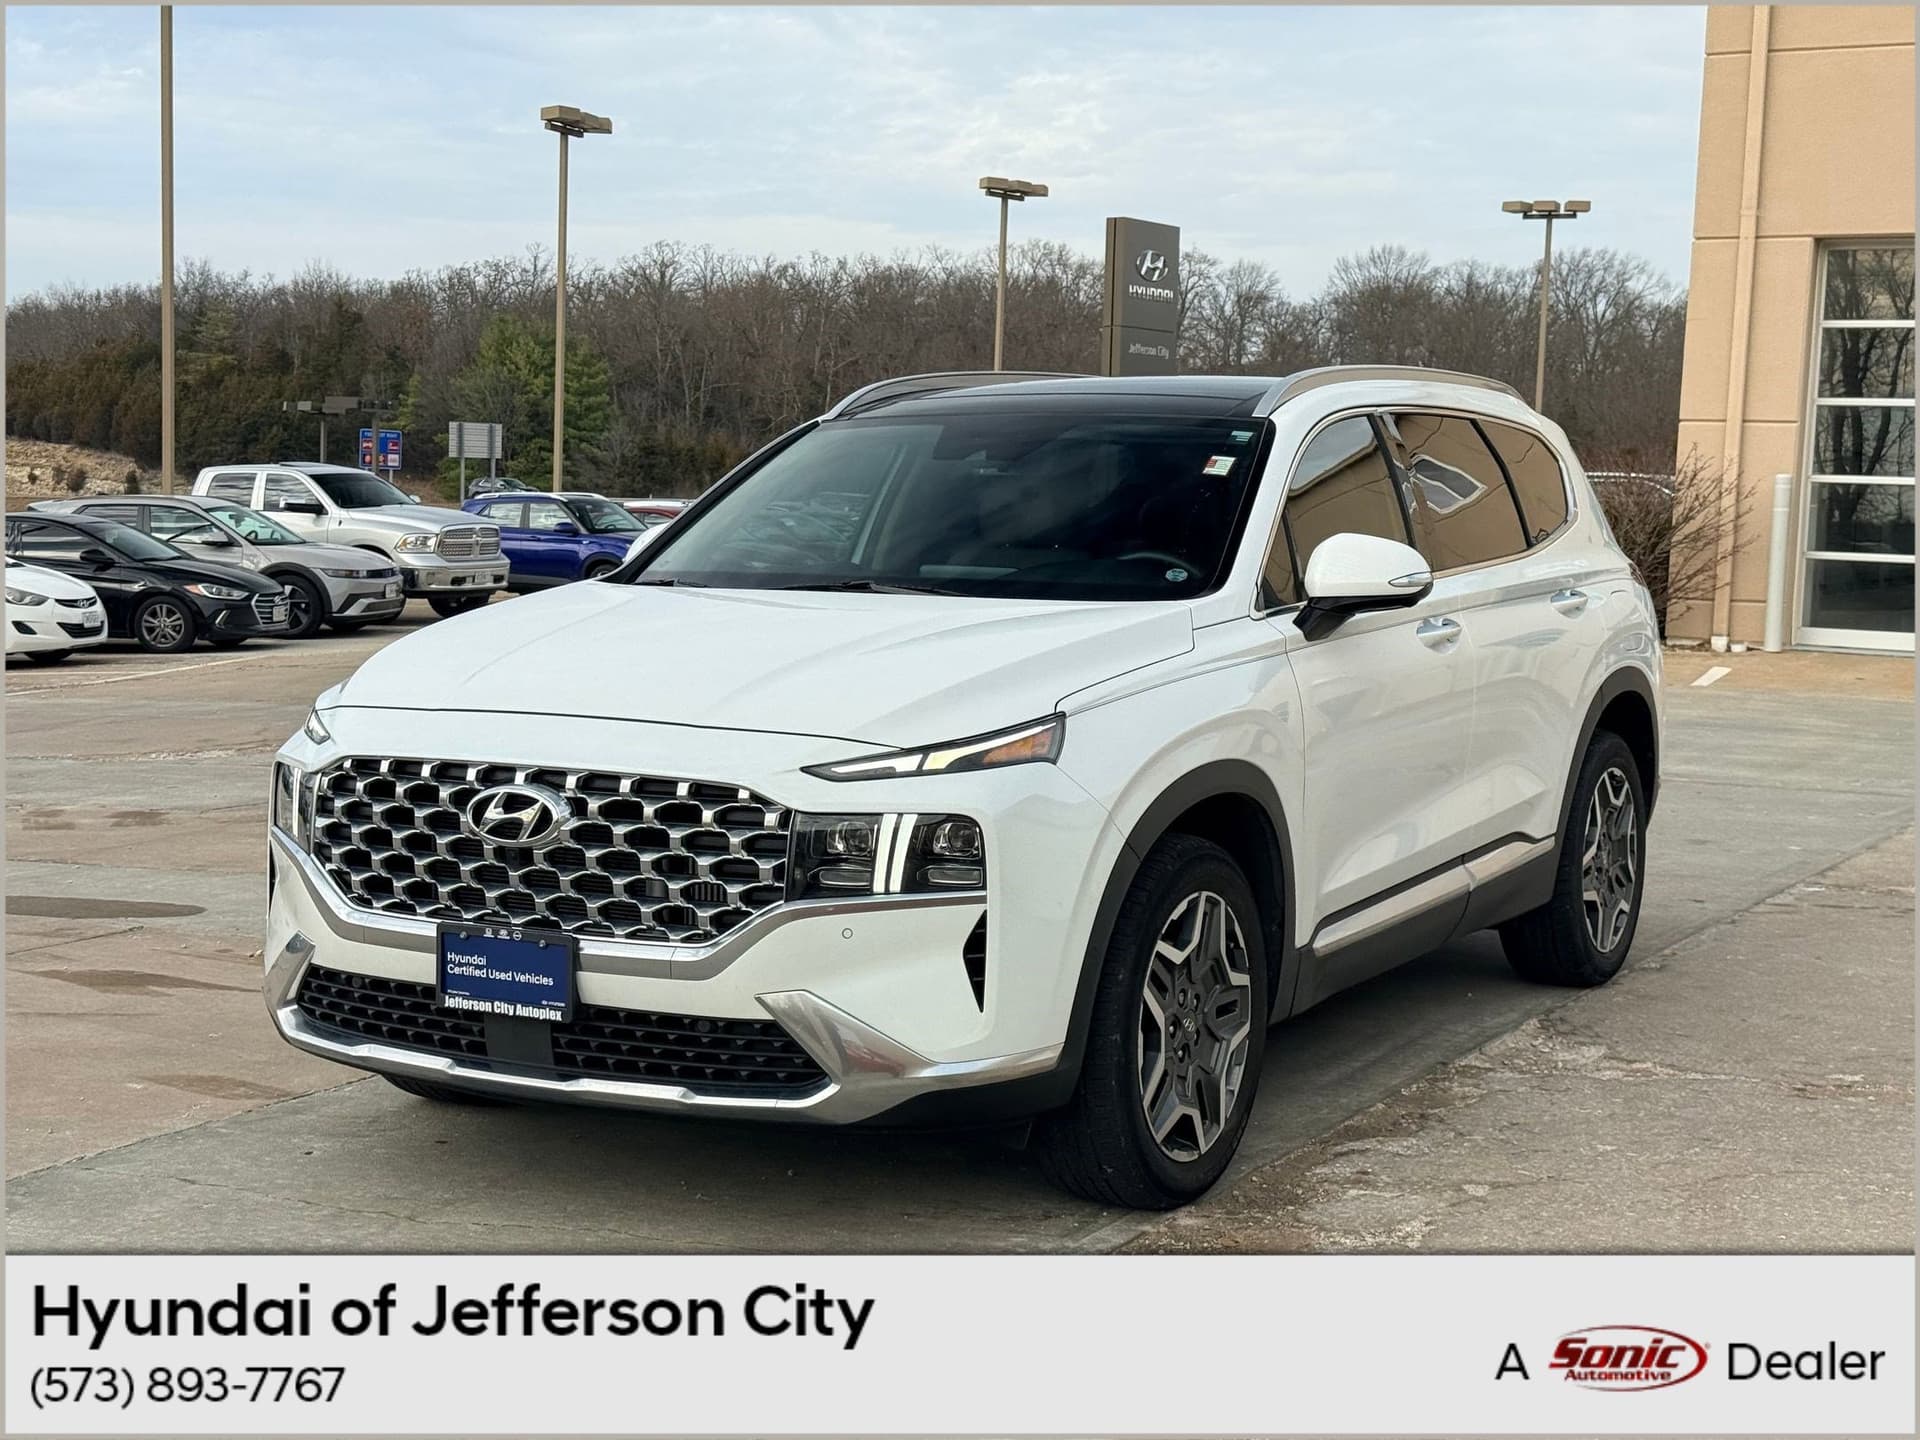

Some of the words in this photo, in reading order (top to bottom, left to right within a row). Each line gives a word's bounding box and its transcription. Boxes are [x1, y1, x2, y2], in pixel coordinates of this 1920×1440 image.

[1129, 284, 1174, 298] HYUNDAI
[447, 952, 487, 966] Hyundai
[447, 964, 487, 978] Certified
[488, 971, 512, 981] Used
[513, 972, 554, 986] Vehicles
[444, 995, 492, 1013] Jefferson
[493, 1001, 514, 1016] City
[515, 1004, 562, 1021] Autoplex
